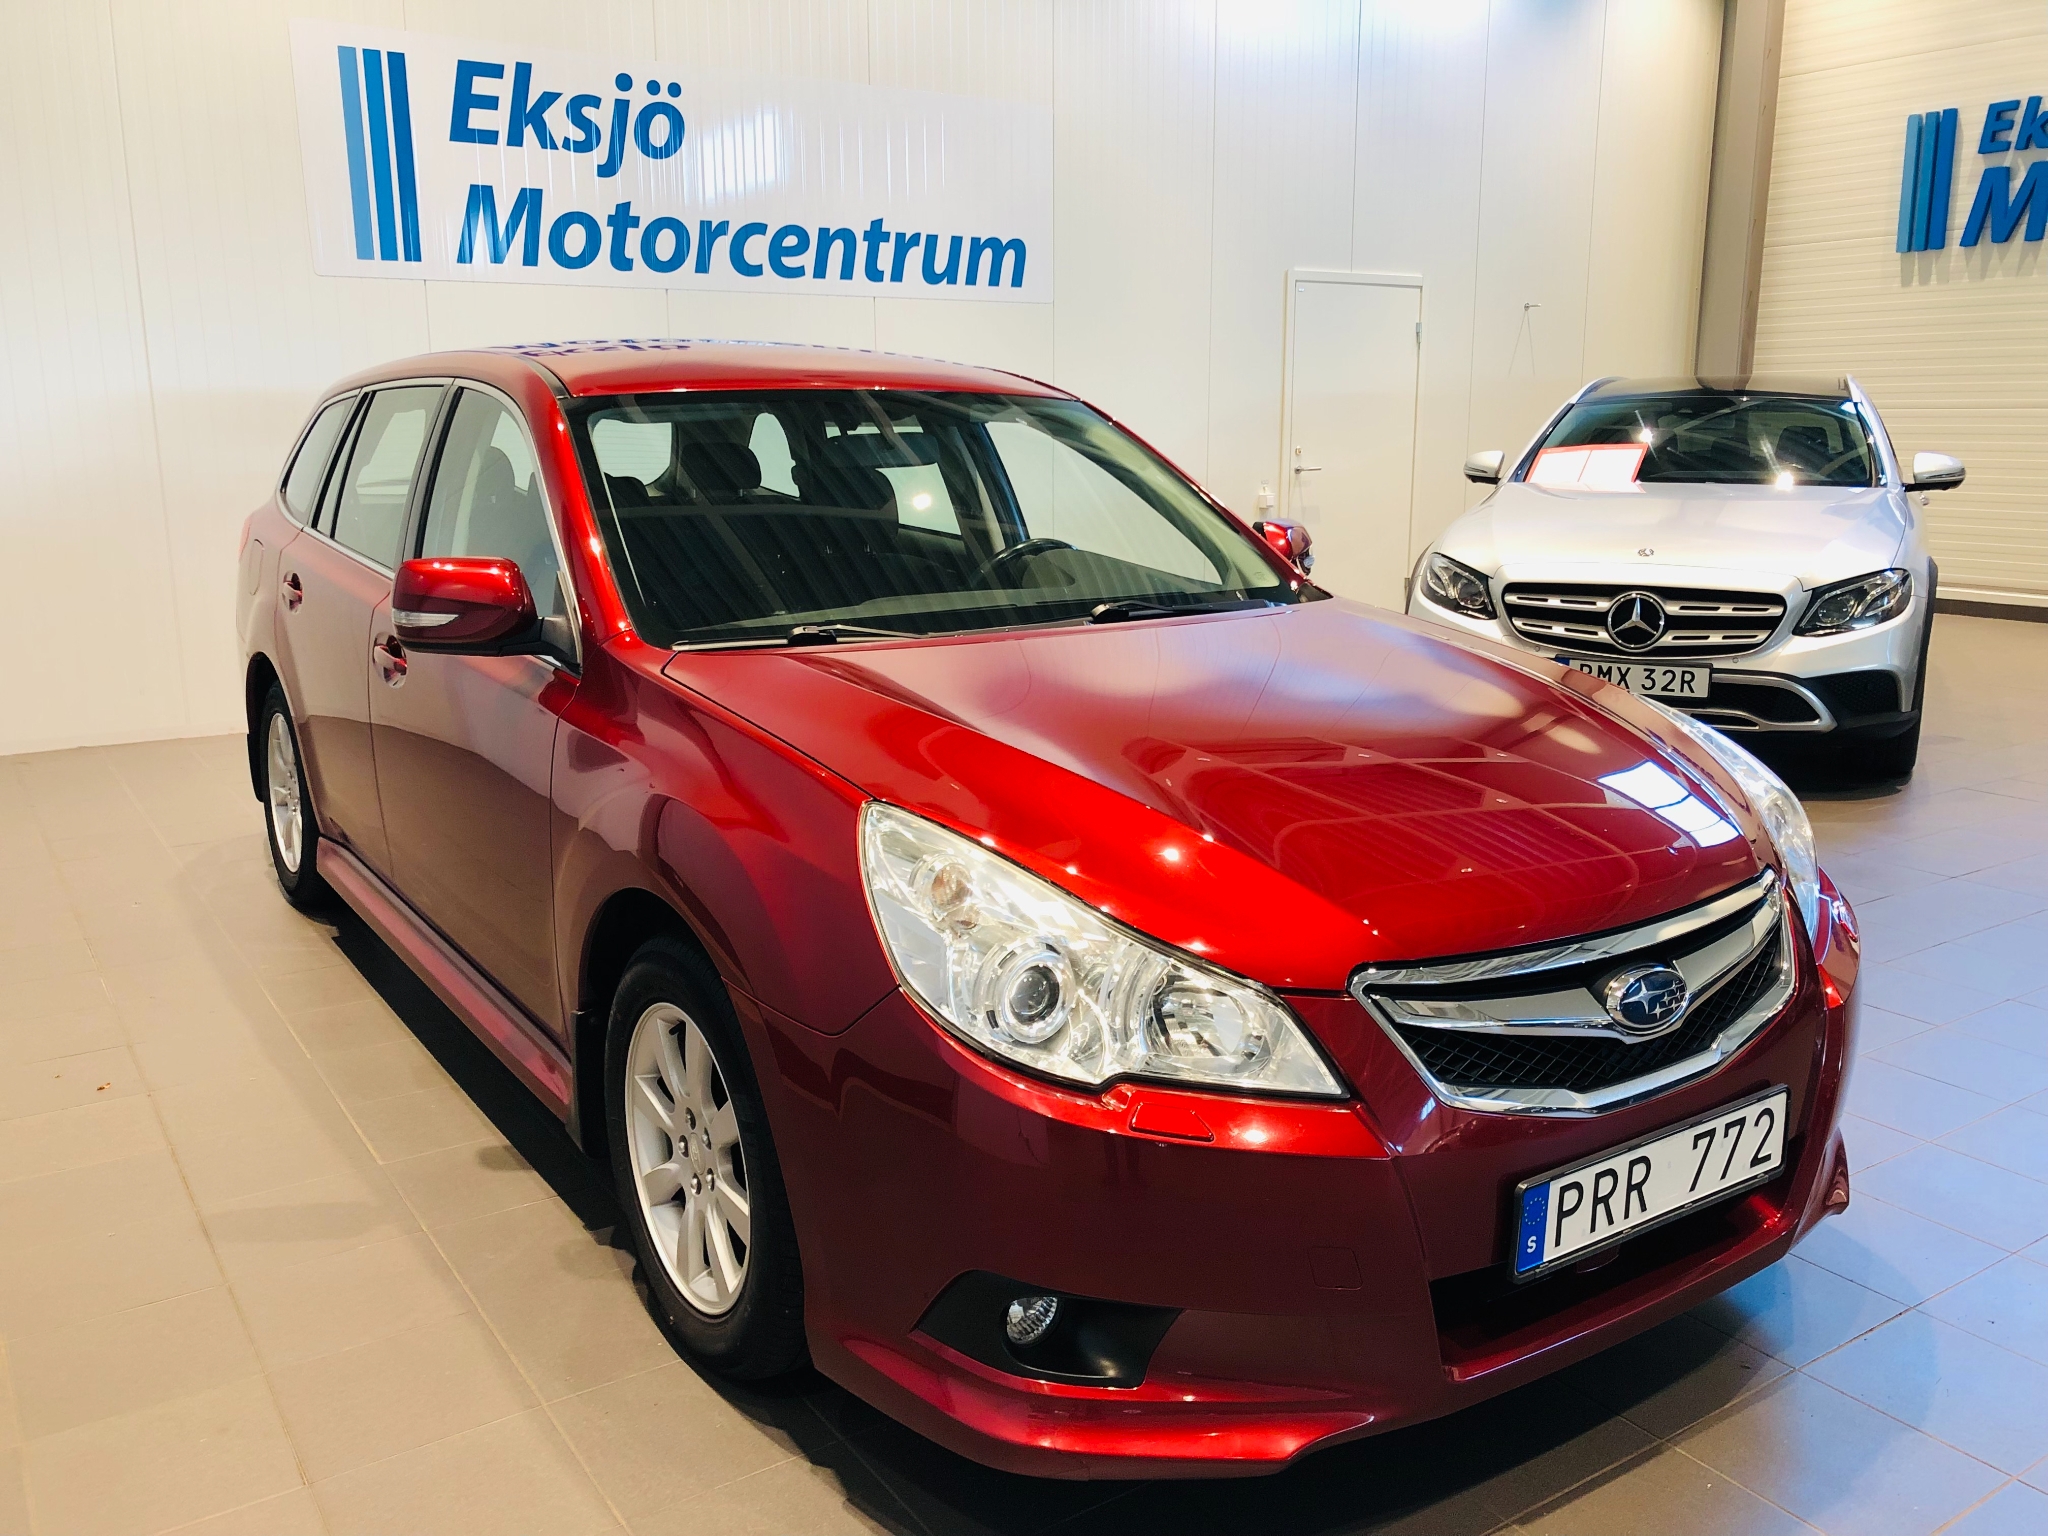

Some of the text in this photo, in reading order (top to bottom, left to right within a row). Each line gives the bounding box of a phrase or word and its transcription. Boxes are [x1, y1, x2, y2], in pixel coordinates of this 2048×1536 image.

[448, 59, 686, 178] Eksjö
[456, 184, 1027, 288] Motorcentrum
[1641, 667, 1696, 694] 32R
[1554, 1107, 1775, 1248] PRR 772
[1526, 1235, 1537, 1253] S
